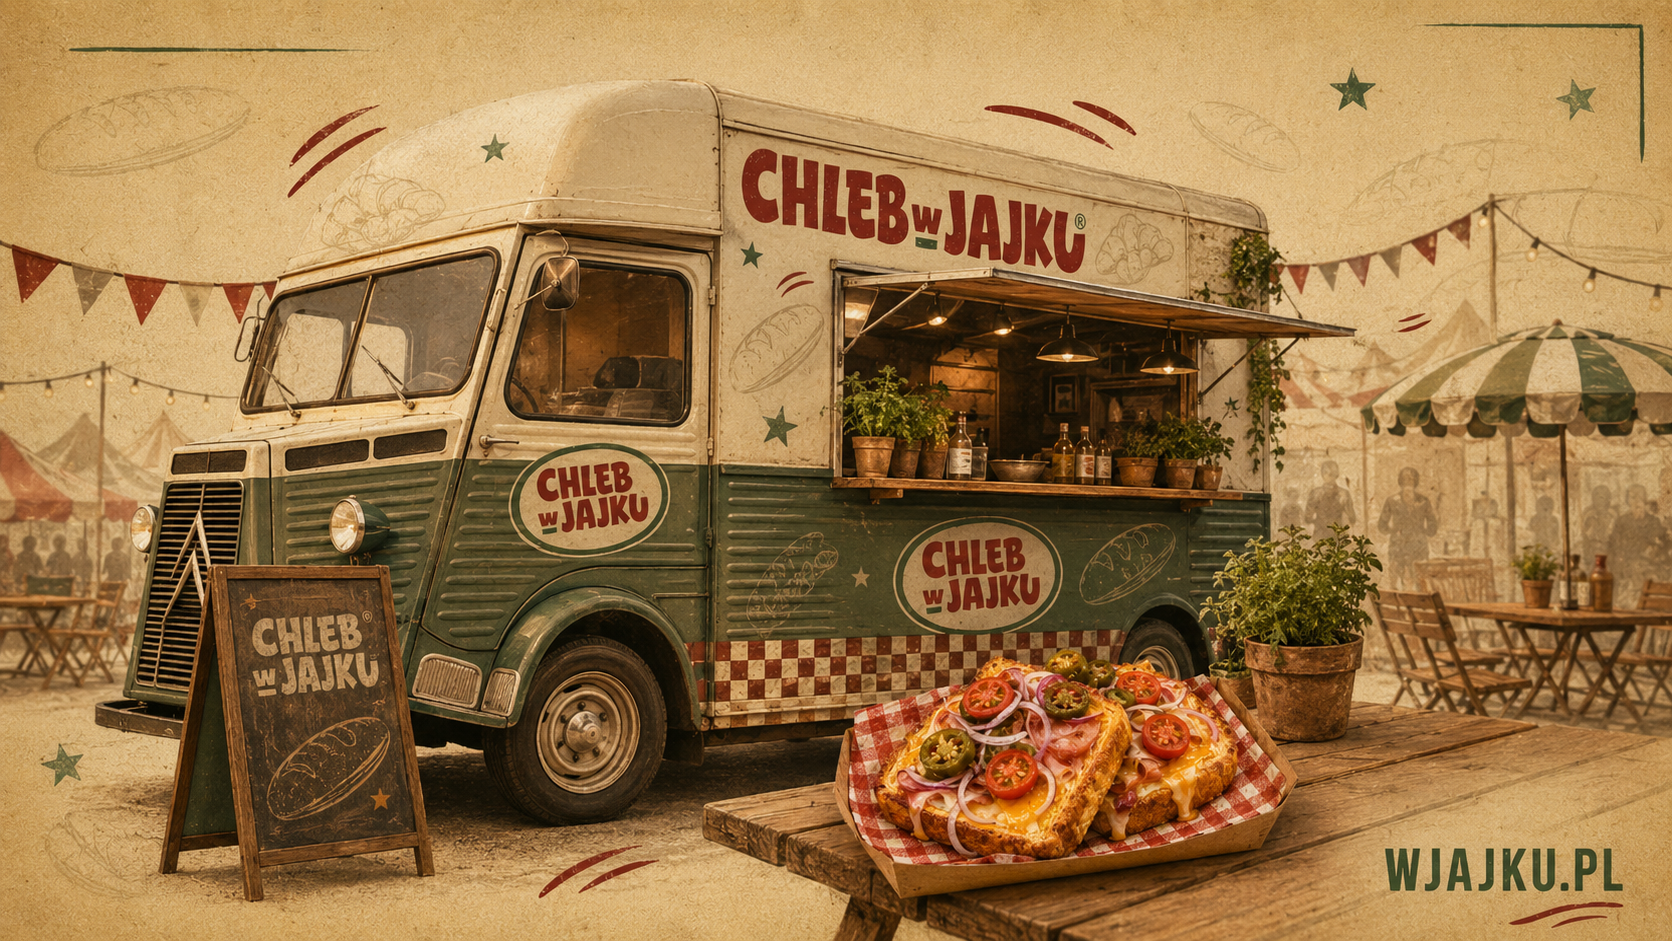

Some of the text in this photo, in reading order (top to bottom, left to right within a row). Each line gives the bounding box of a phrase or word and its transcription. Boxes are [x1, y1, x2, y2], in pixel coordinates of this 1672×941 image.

[742, 148, 908, 245] CHLEB
[536, 461, 633, 502] CHLEB
[561, 493, 649, 533] JAJKU
[922, 537, 1026, 579] CHLEB
[946, 573, 1041, 613] JAJKU
[281, 652, 380, 696] JAJKU
